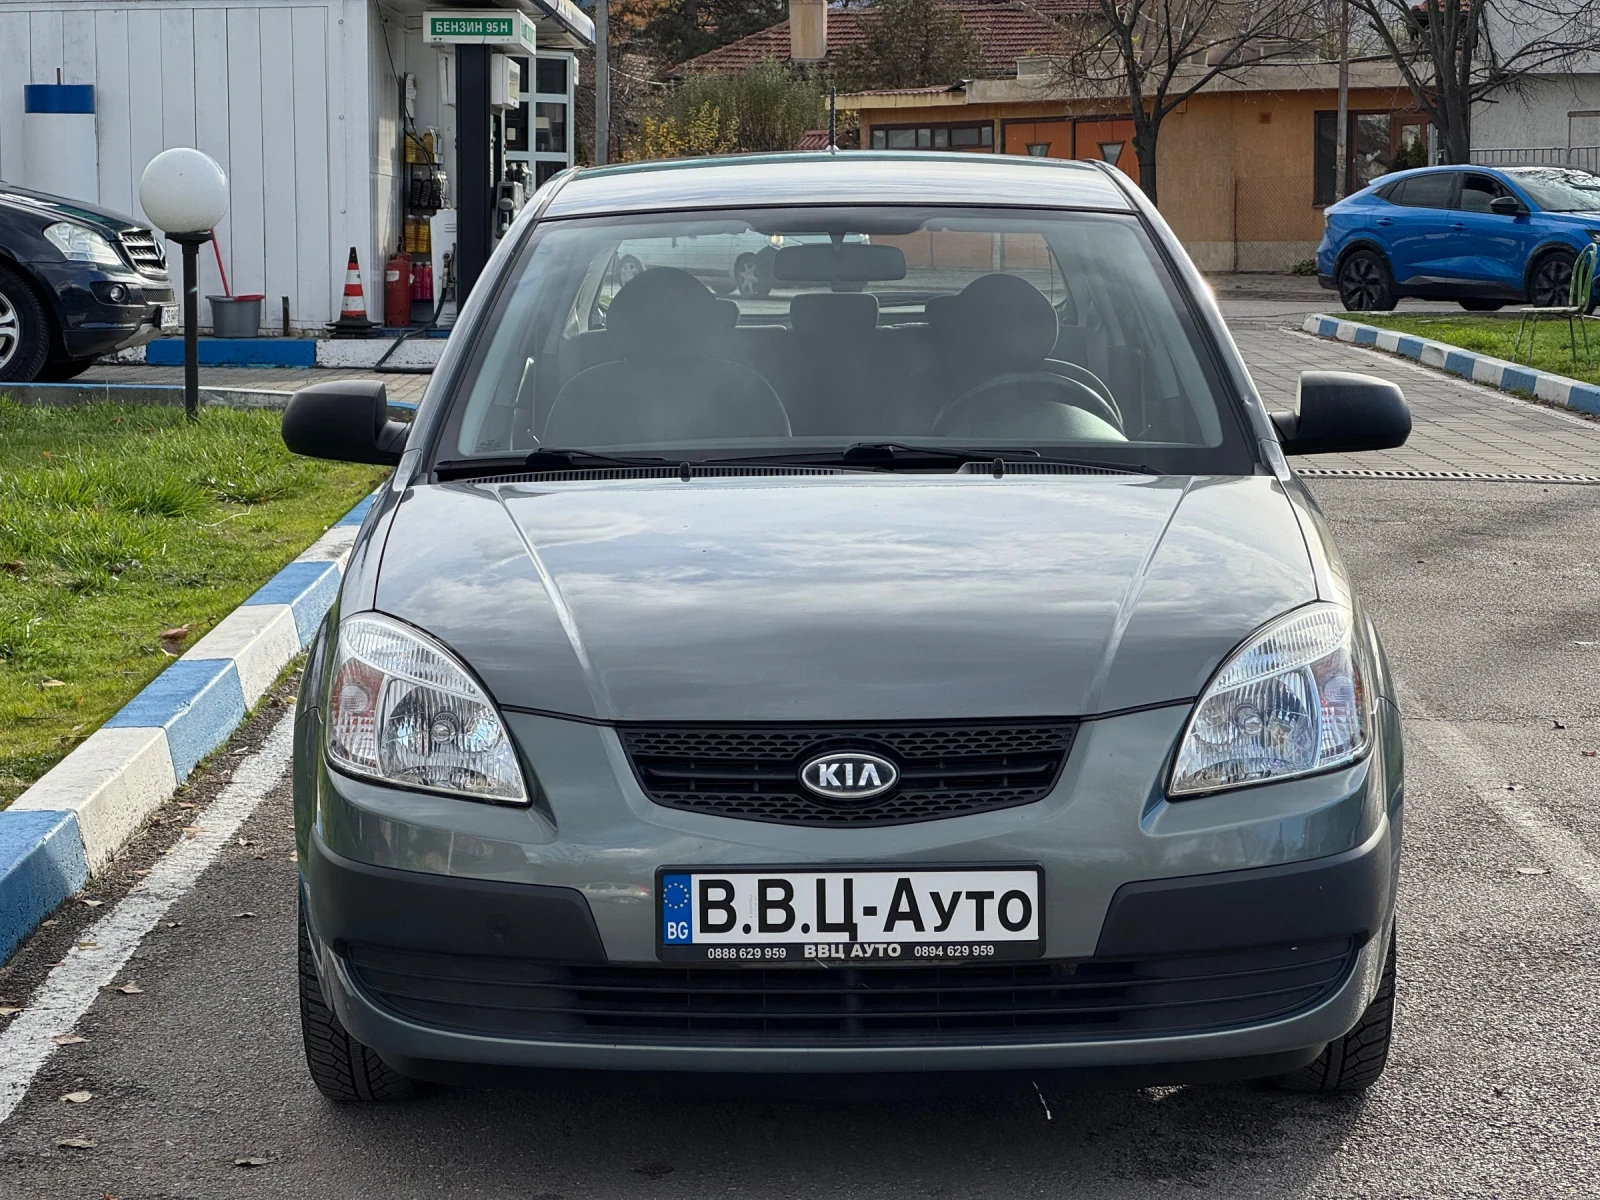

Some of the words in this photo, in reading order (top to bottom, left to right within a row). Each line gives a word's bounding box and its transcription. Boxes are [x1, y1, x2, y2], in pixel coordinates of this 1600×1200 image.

[435, 21, 483, 33] БЕНЗИН
[817, 763, 882, 786] KIA
[698, 877, 1033, 941] В.В.Ц-Ауто
[667, 921, 689, 940] BG
[707, 948, 737, 959] 0888
[739, 948, 762, 959] 629
[764, 947, 787, 958] 959
[804, 944, 845, 959] ВВЦ
[850, 943, 901, 958] АУТО
[914, 946, 944, 957] 0894
[946, 945, 969, 956] 629
[972, 945, 995, 956] 959
